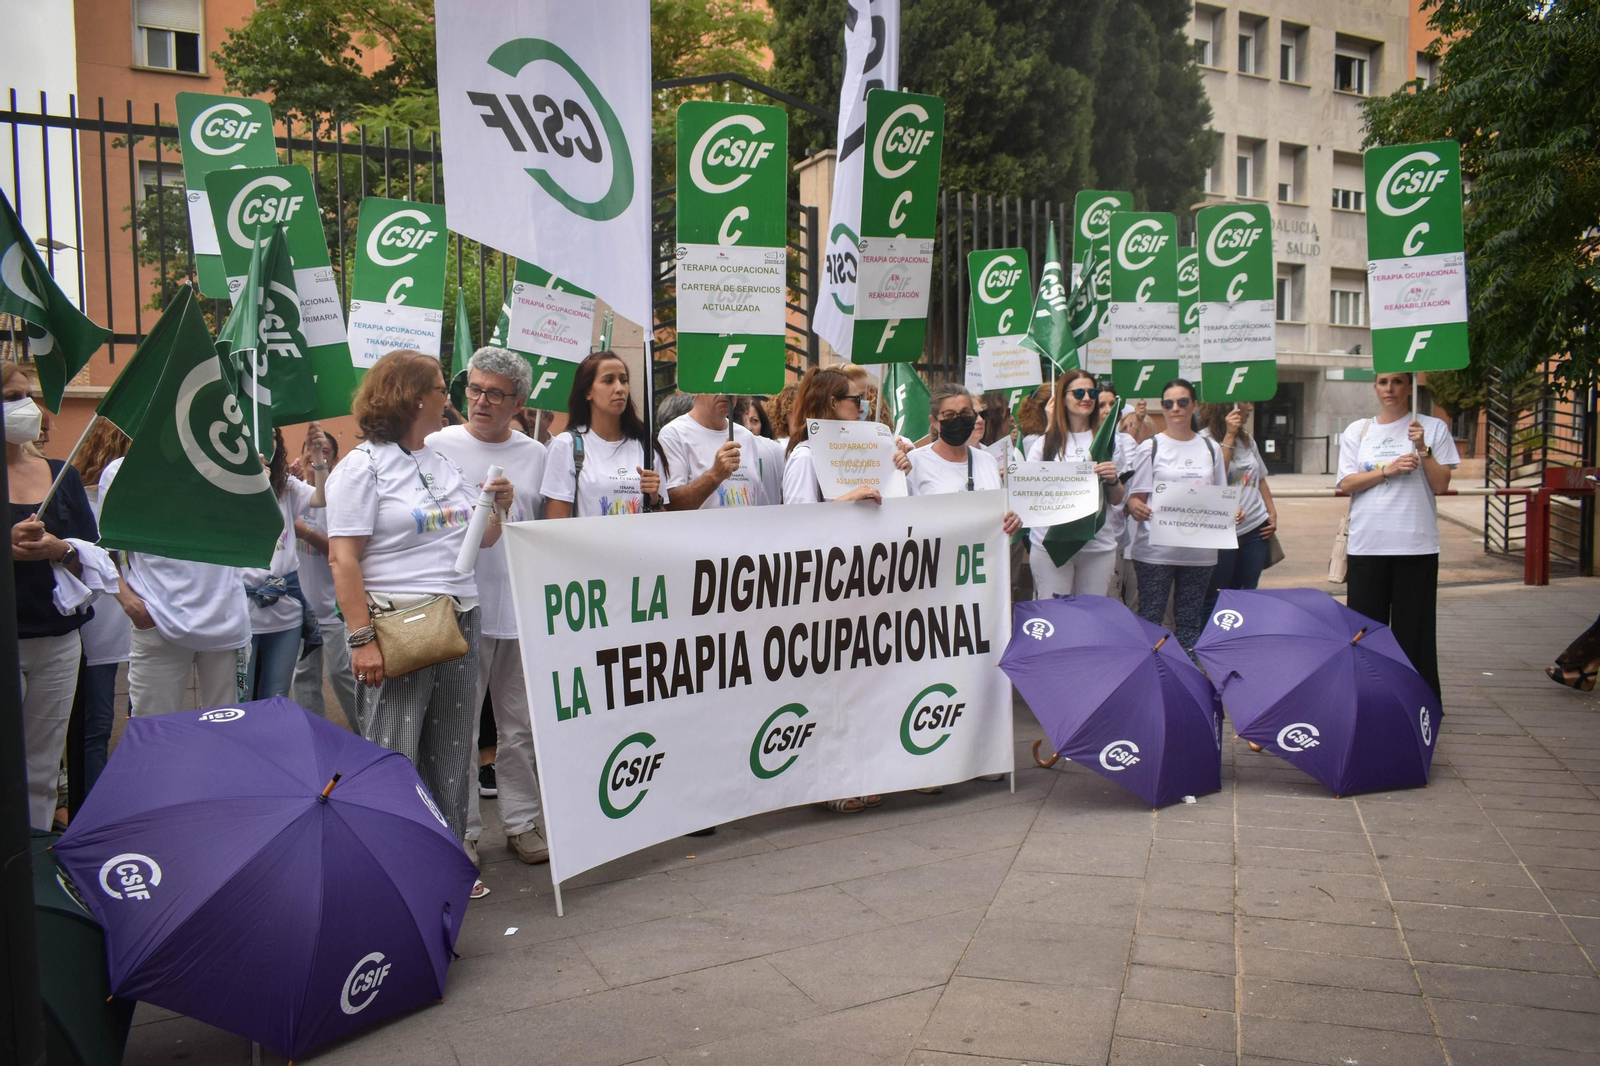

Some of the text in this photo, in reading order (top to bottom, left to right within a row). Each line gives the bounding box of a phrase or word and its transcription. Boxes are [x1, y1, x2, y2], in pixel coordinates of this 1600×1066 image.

[205, 118, 262, 140] CSIF
[886, 126, 935, 155] CSIF
[707, 138, 775, 168] CSIF
[1390, 169, 1450, 196] CSIF
[243, 196, 304, 225] CSIF
[889, 190, 913, 229] C
[718, 206, 750, 246] C
[381, 226, 438, 250] CSIF
[1128, 234, 1169, 253] CSIF
[1217, 227, 1263, 248] CSIF
[1402, 222, 1430, 256] C
[863, 255, 887, 263] TERAPIA
[1287, 241, 1321, 257] SALUD
[682, 263, 780, 275] TERAPIA OCUPACIONAL
[987, 269, 1022, 288] CSIF
[1372, 269, 1458, 281] TERAPIA OCUPACIONAL
[681, 283, 721, 292] CARTERA
[737, 285, 781, 294] SERVICIOS
[869, 291, 919, 299] REAHABILITACIÓN
[518, 297, 545, 309] TERAPIA
[546, 303, 591, 320] OCUPACIONAL
[702, 303, 761, 312] ACTUALIZADA
[1384, 300, 1451, 311] REAHABILITACIÓN
[353, 322, 436, 338] TERAPIA OCUPACIONAL
[548, 319, 558, 327] EN
[365, 338, 421, 350] TRANPARENCIA
[521, 327, 579, 346] REAHABILITACIÓN
[1404, 330, 1433, 363] F
[364, 352, 374, 360] EN
[713, 344, 748, 382] F
[530, 371, 558, 399] F
[1133, 365, 1155, 391] F
[1226, 366, 1249, 395] F
[829, 442, 878, 450] EQUIPARACIÓN
[830, 460, 881, 468] RETRIBUCIONES
[1055, 489, 1091, 497] SERVICIOS
[1029, 503, 1075, 511] ACTUALIZADA
[1160, 505, 1230, 517] TERAPIA OCUPACIONAL
[1168, 520, 1198, 528] ATENCIÓN
[544, 526, 987, 635] POR LA DIGNIFICACIÓN DE
[552, 602, 990, 722] LA TERAPIA OCUPACIONAL
[913, 702, 966, 732] CSIF
[763, 722, 817, 755] CSIF
[1286, 728, 1320, 749] CSIF
[1108, 748, 1141, 767] CSIF
[612, 752, 666, 791] CSIF
[116, 863, 151, 901] CSIF
[351, 962, 392, 996] CSIF
